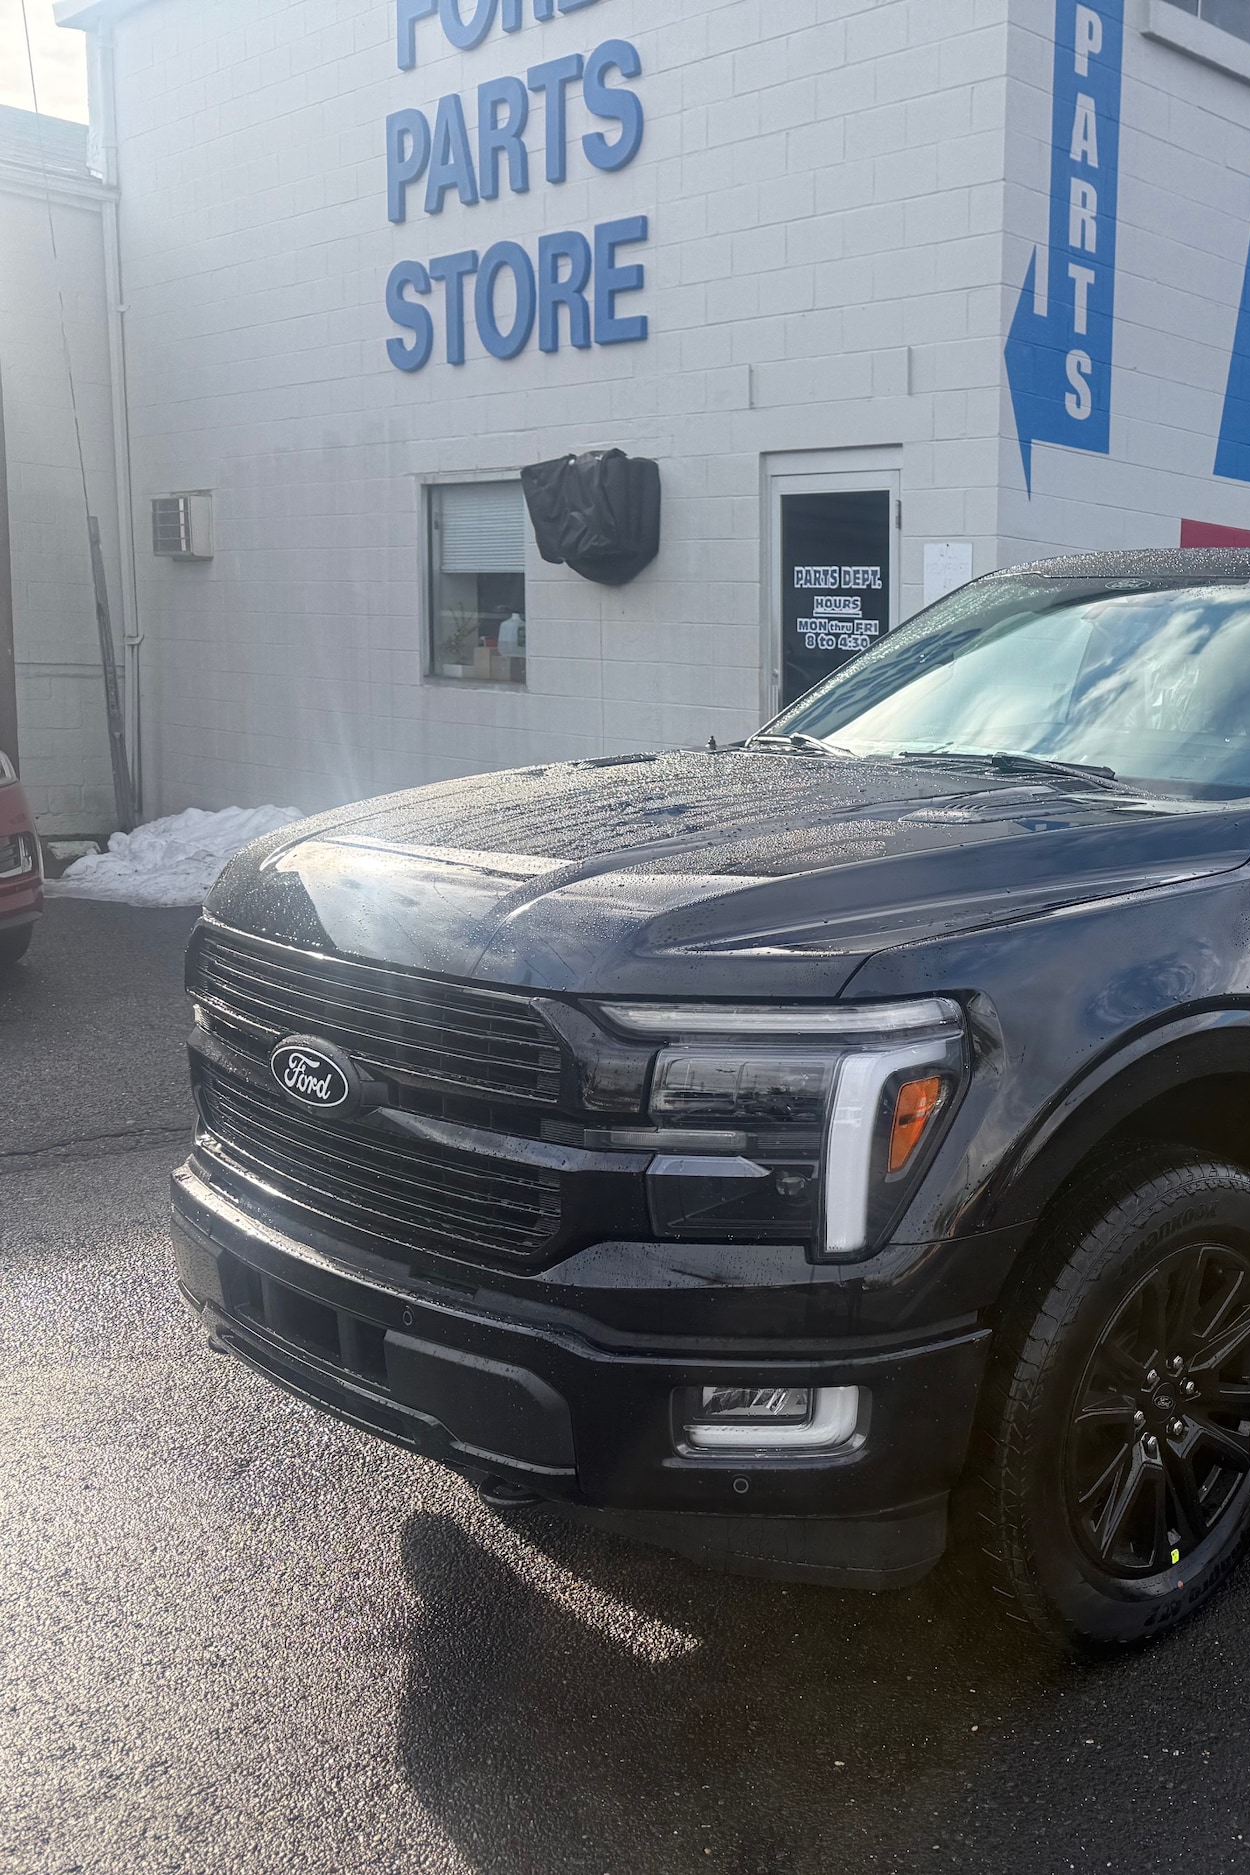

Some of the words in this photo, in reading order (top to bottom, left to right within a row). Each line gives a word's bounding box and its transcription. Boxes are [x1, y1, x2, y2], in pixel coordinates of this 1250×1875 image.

[386, 39, 644, 224] PARTS
[1065, 3, 1103, 421] PARTS
[385, 215, 648, 373] STORE
[794, 566, 839, 589] PARTS
[841, 566, 883, 589] DEPT.
[814, 596, 861, 612] HOURS
[797, 618, 828, 632] MON
[828, 620, 853, 633] thru
[854, 620, 879, 635] FRI
[805, 633, 816, 649] 8
[817, 634, 836, 649] to
[838, 634, 870, 651] 4:30
[284, 1052, 332, 1100] Ford
